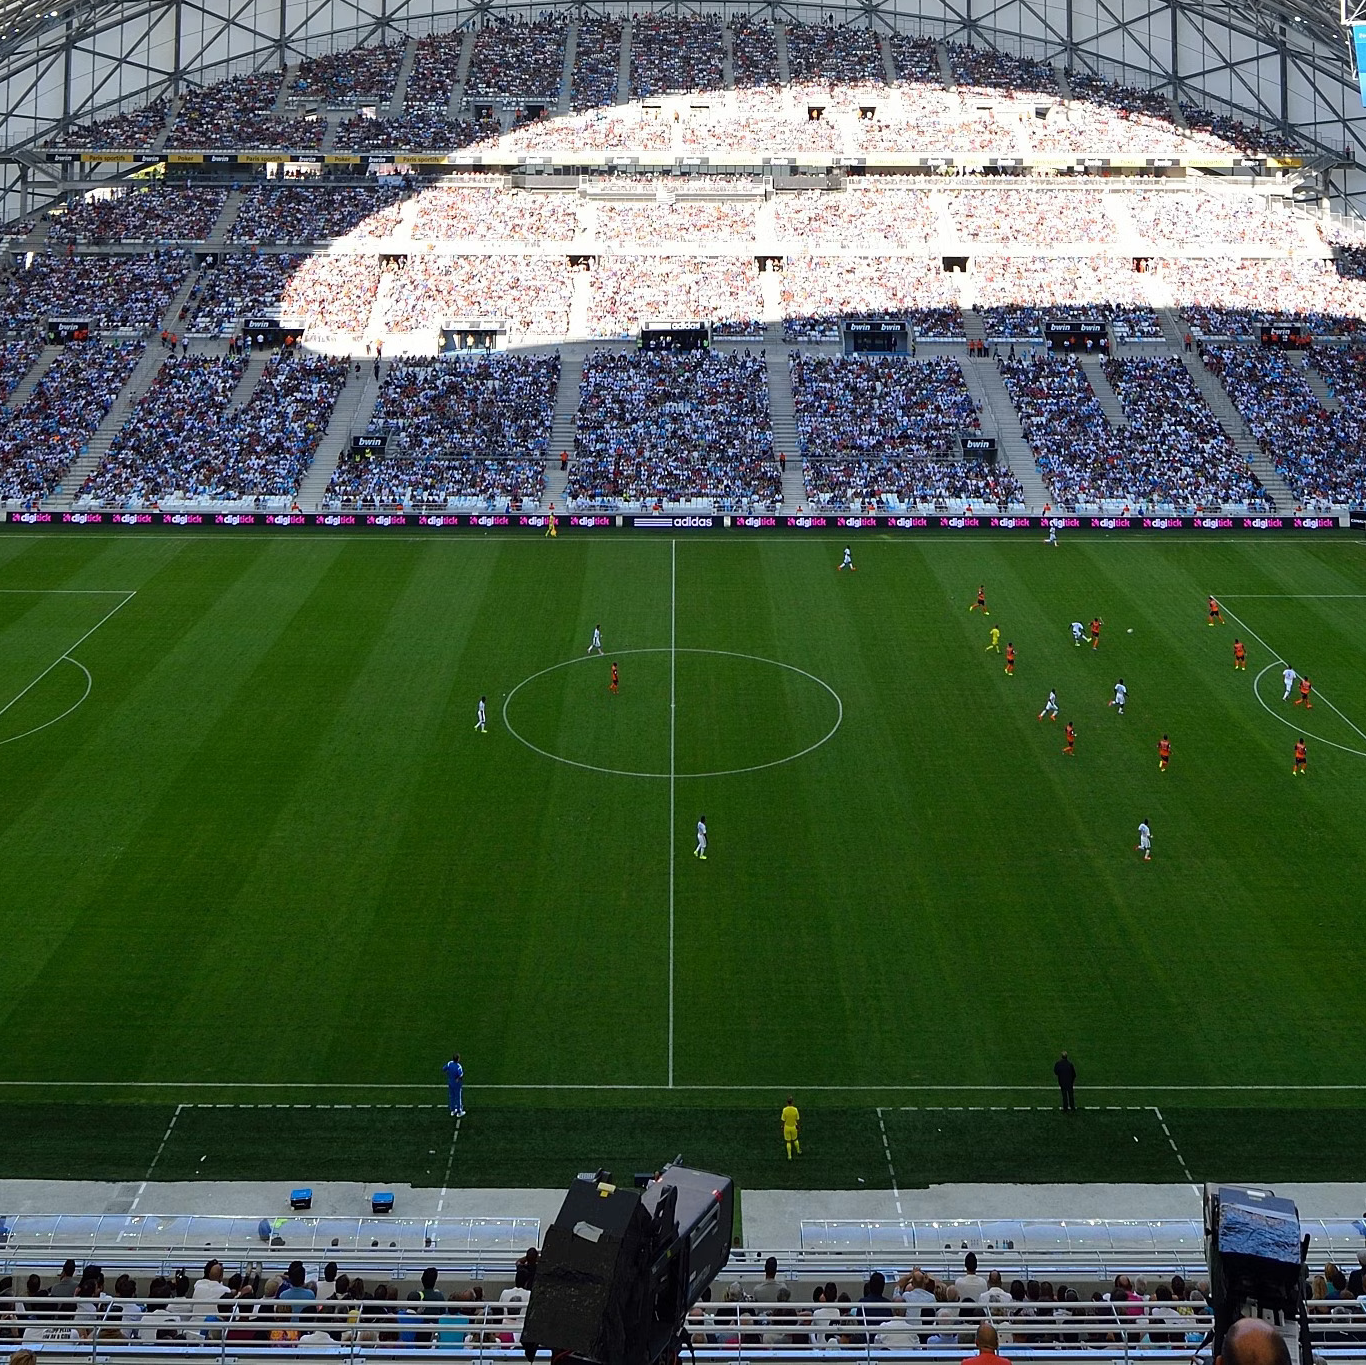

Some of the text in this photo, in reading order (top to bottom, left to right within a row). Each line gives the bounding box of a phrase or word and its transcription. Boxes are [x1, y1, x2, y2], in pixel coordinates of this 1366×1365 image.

[58, 323, 78, 331] bwin
[249, 320, 269, 328] bwin
[671, 322, 701, 330] adidas
[850, 323, 901, 331] bwin bwin
[1050, 323, 1101, 331] bwin bwin
[359, 437, 381, 446] bwin
[967, 440, 989, 449] bwin
[21, 512, 51, 524] digitick
[71, 512, 101, 524] digitick
[121, 512, 151, 524] digitick
[171, 512, 202, 524] digitick
[224, 512, 254, 524] digitick
[274, 516, 305, 527] digitick
[326, 516, 355, 527] digitick
[377, 516, 405, 527] digitick
[429, 516, 458, 527] digitick
[479, 516, 509, 527] digitick
[579, 516, 609, 527] digitick
[674, 517, 713, 527] adidas
[745, 517, 776, 528] digitick
[796, 517, 826, 528] digitick
[846, 517, 876, 528] digitick
[897, 517, 927, 528] digitick
[948, 517, 979, 528] digitick
[999, 517, 1030, 528] digitick
[1100, 517, 1130, 528] digitick
[1152, 517, 1182, 528] digitick
[1202, 517, 1233, 528] digitick
[1252, 517, 1283, 528] digitick
[1302, 517, 1333, 528] digitick
